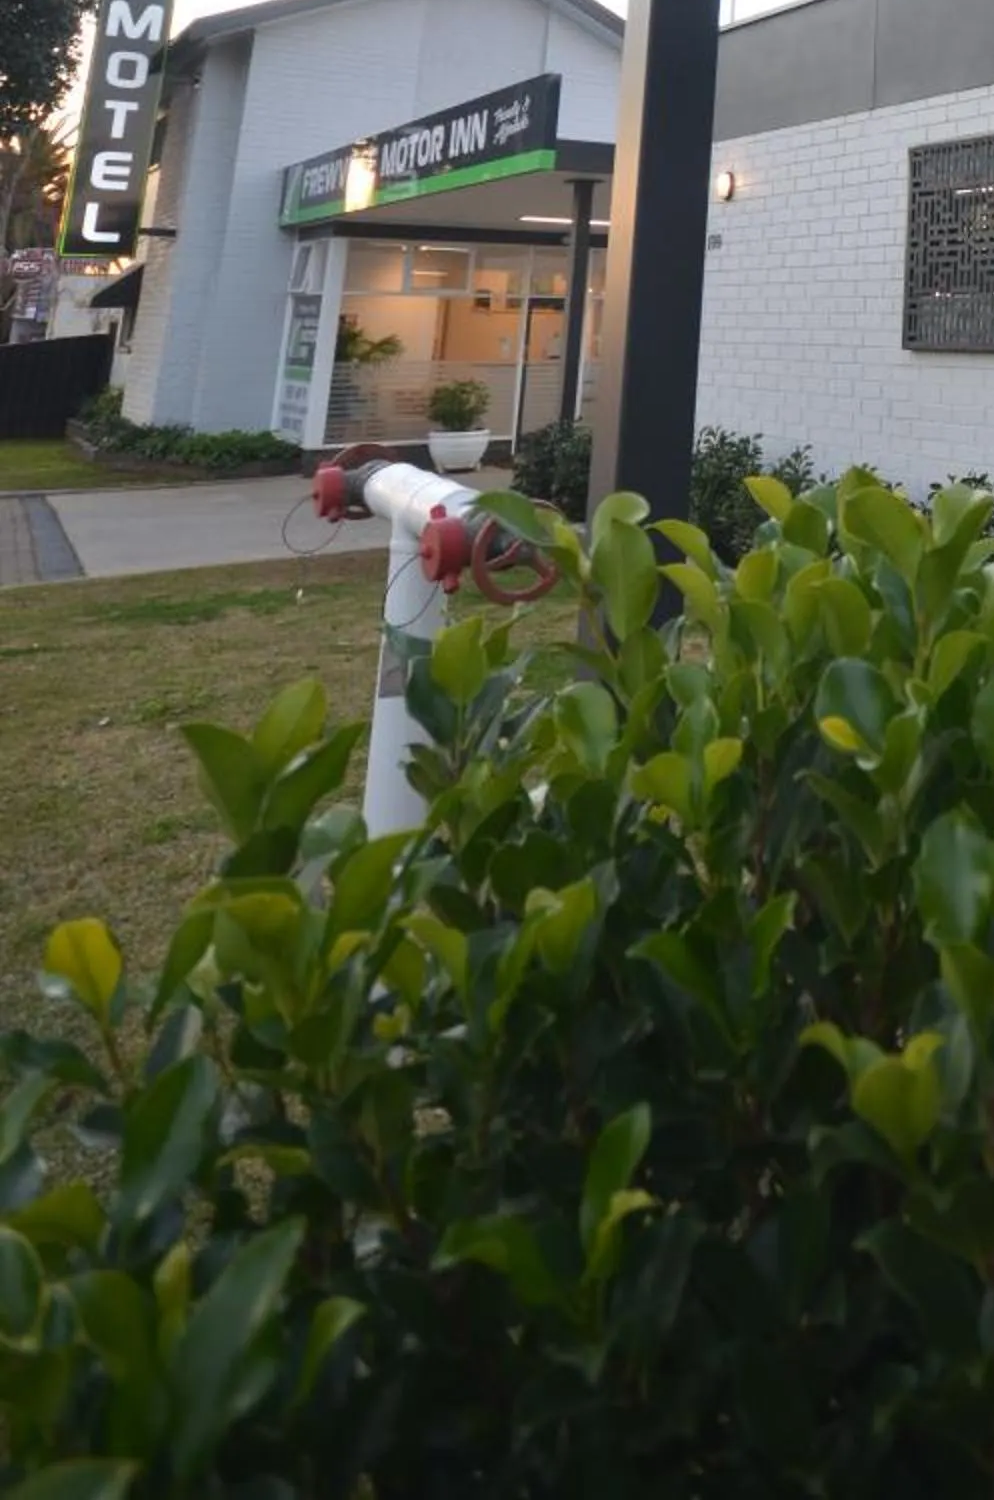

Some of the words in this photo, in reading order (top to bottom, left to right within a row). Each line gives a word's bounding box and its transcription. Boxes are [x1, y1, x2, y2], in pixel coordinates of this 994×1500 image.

[81, 0, 165, 243] MOTEL
[380, 124, 445, 177] MOTOR
[448, 109, 489, 159] INN
